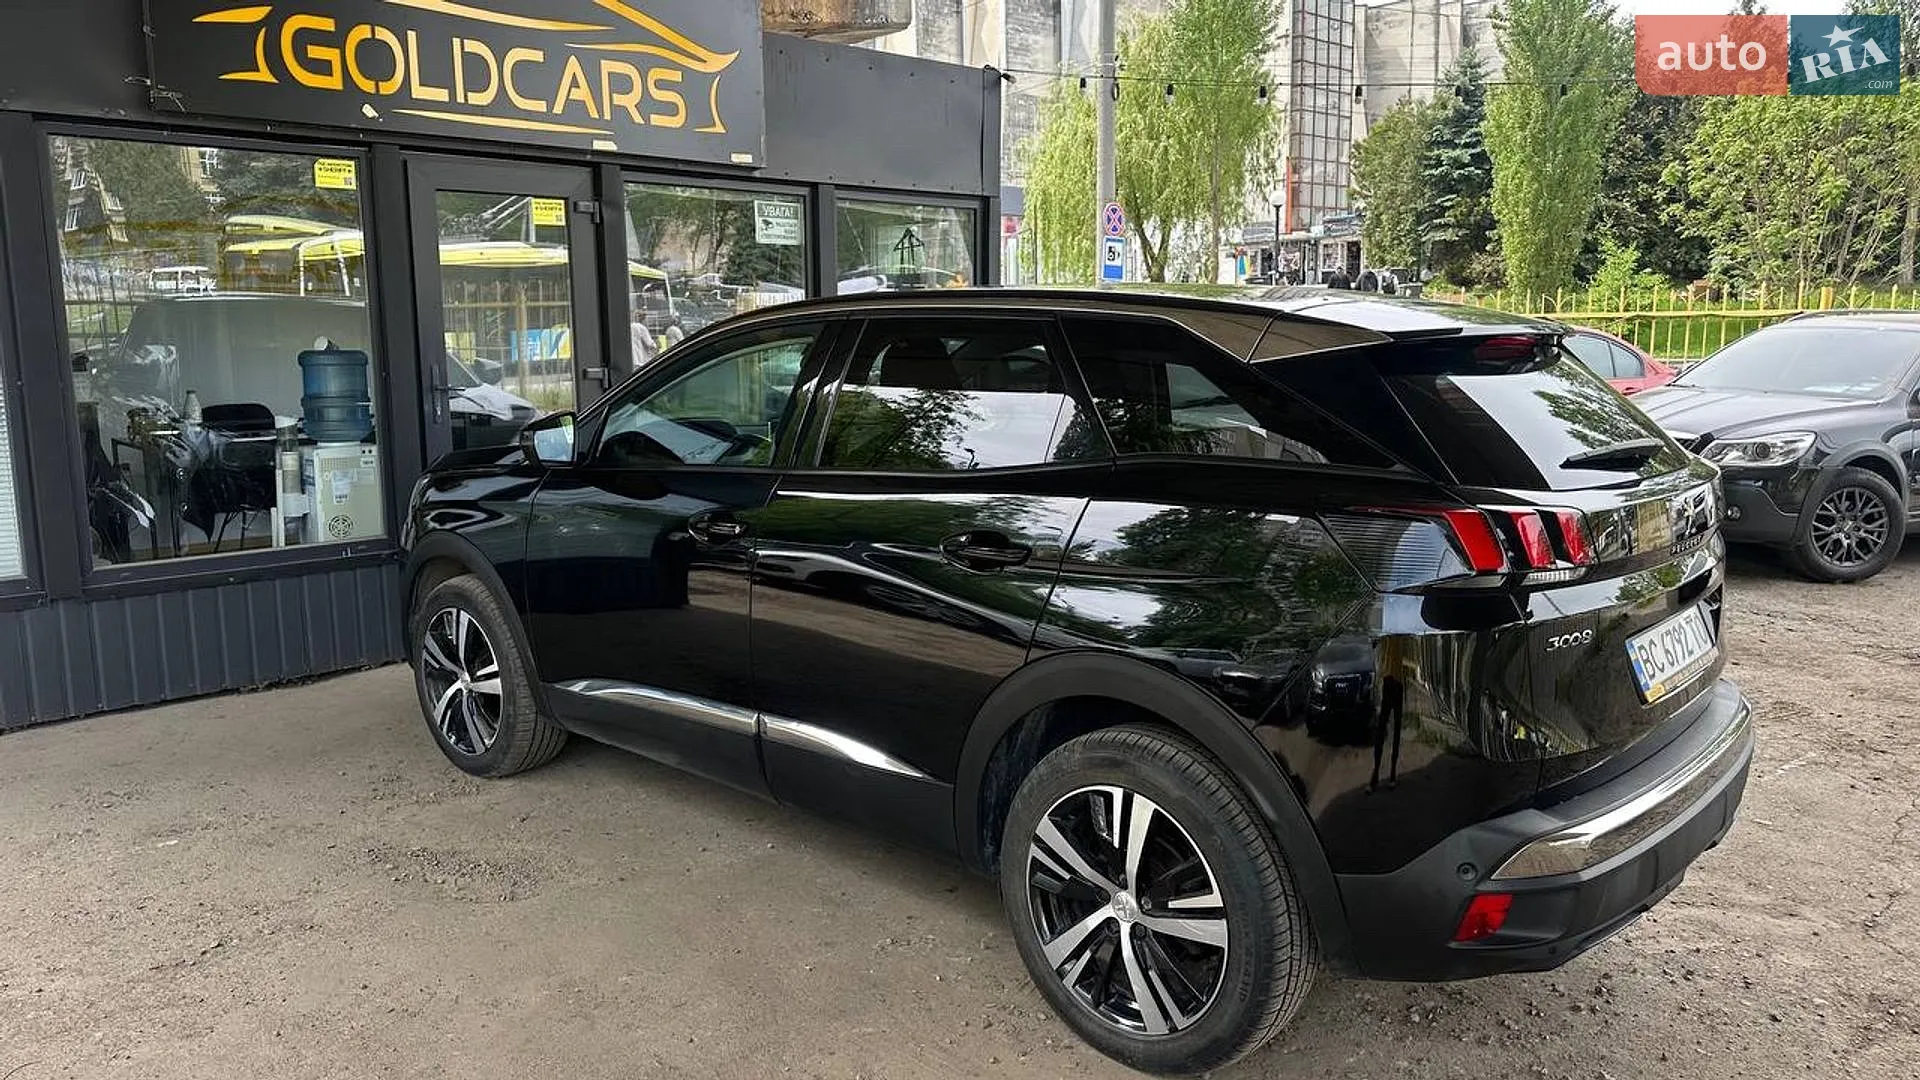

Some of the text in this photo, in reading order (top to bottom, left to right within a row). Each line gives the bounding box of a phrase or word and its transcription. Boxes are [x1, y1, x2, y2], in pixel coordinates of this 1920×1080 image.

[280, 13, 689, 129] GOLDCARS
[761, 203, 793, 217] УВАГА!
[1546, 629, 1593, 651] 3008
[1636, 638, 1665, 680] BC
[1660, 622, 1694, 668] 6792
